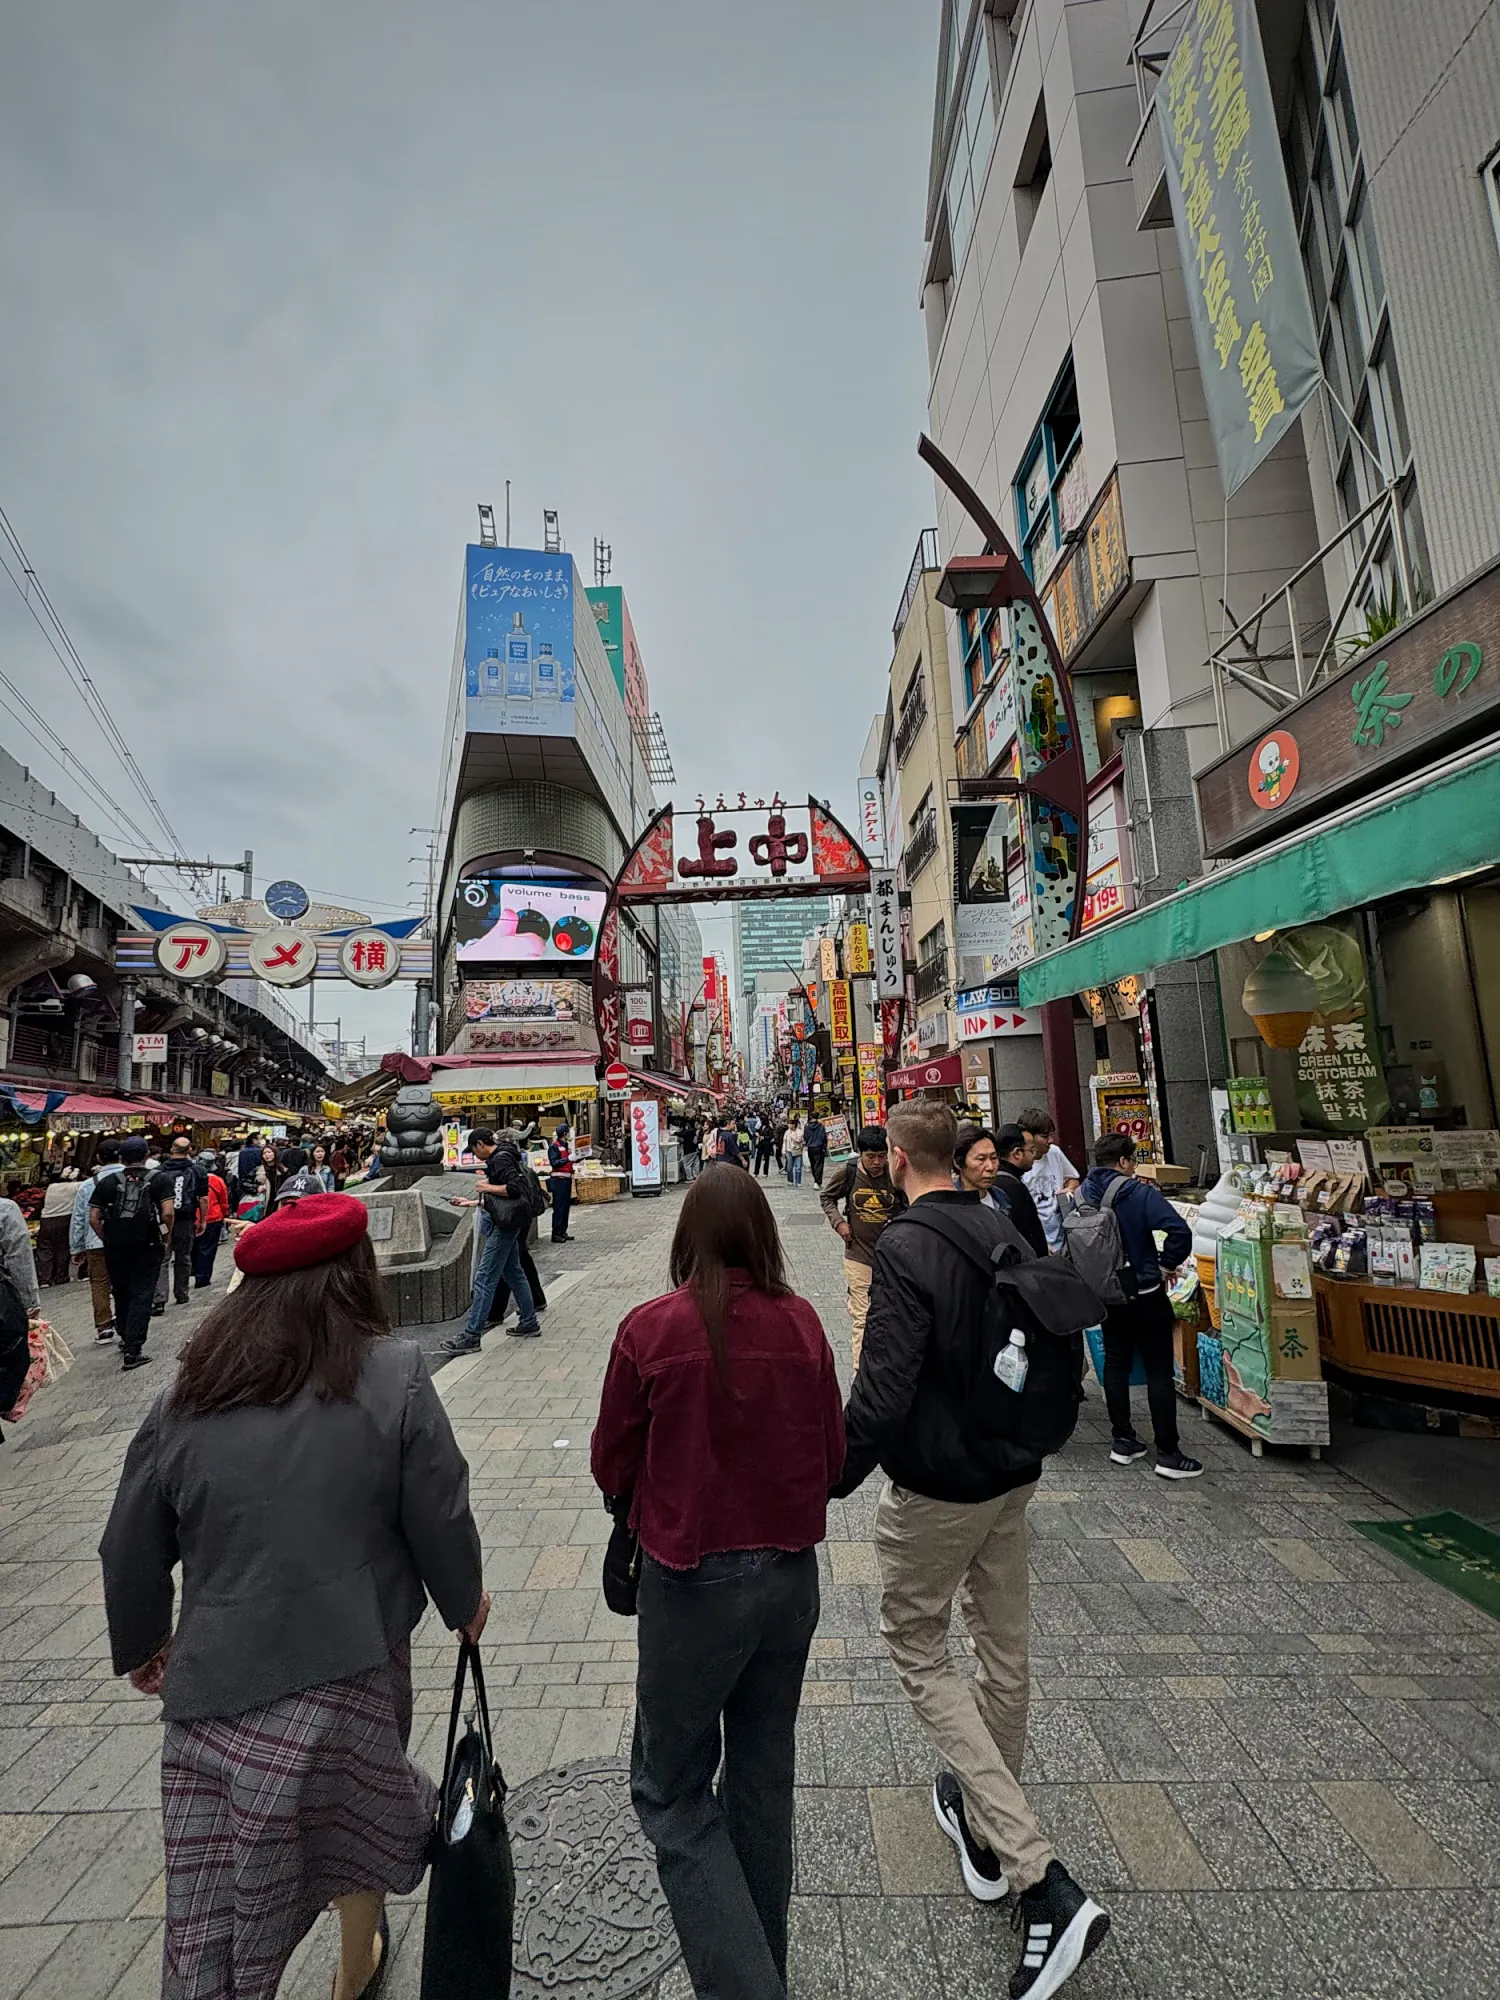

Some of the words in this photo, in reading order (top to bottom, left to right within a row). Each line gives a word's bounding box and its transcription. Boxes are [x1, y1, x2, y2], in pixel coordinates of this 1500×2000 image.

[1168, 31, 1242, 370] 農林水産大臣賞
[1232, 151, 1274, 303] 茶の君野園
[1238, 320, 1284, 443] 受賞
[1352, 641, 1482, 747] 茶の
[695, 791, 787, 811] うえちゅん
[864, 802, 879, 843] アドアーズ
[677, 814, 808, 878] 上中
[507, 888, 552, 898] volume
[559, 891, 591, 901] bass
[853, 926, 864, 972] おたからや
[875, 879, 897, 987] 都まんじゅう
[169, 936, 389, 972] アメ横
[505, 998, 537, 1006] OPEN
[832, 981, 850, 1040] 高価買取
[136, 1036, 164, 1045] ATM
[470, 1030, 575, 1048] アメ横センター
[963, 1016, 978, 1036] IN
[1298, 1065, 1378, 1080] SOFTCREAM
[1299, 1054, 1342, 1067] GREEN
[1343, 1052, 1371, 1065] TEA
[449, 1094, 474, 1105] 毛がに
[477, 1092, 502, 1104] まぐろ
[1315, 1081, 1366, 1101] 抹茶
[1321, 1101, 1368, 1121] 말차
[174, 1176, 185, 1210] adidas
[1279, 1328, 1308, 1360] 茶
